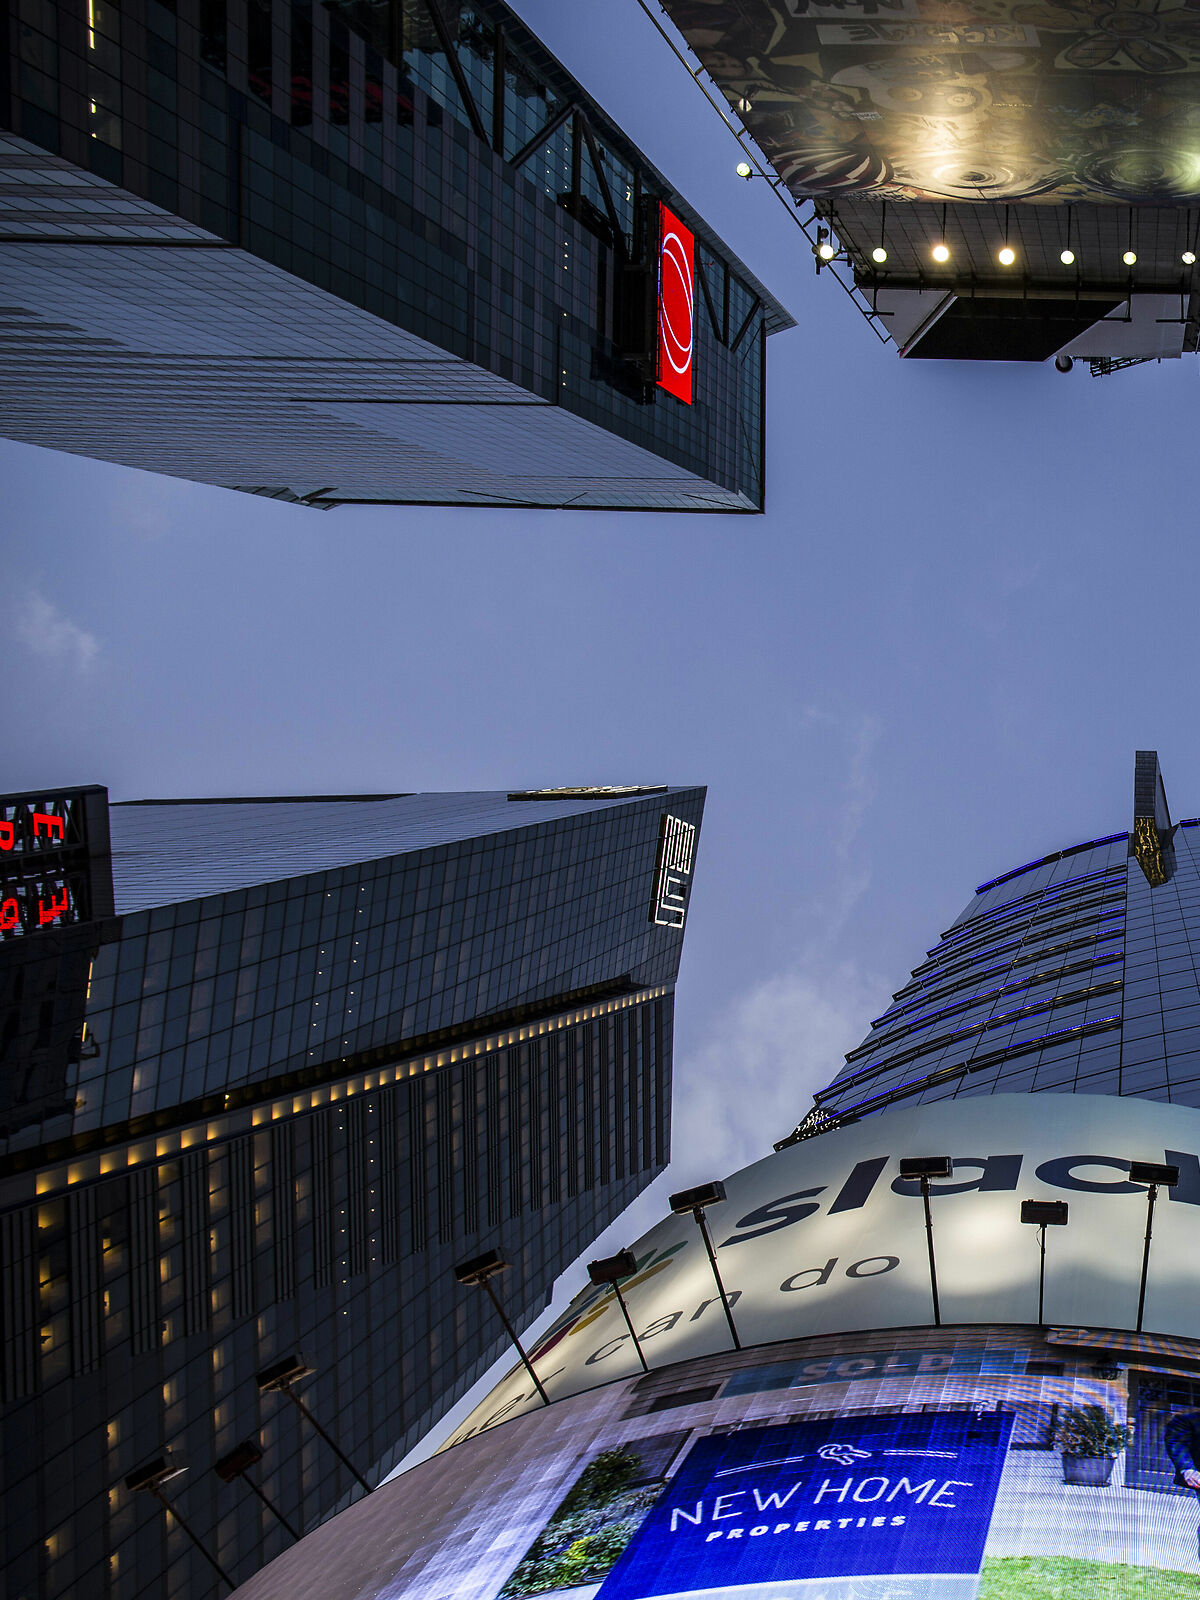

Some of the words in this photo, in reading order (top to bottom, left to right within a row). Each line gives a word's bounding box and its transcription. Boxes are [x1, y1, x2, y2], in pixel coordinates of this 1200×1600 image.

[585, 1291, 742, 1365] can
[780, 1256, 900, 1292] do
[803, 1354, 954, 1382] SOLD
[670, 1482, 802, 1531] NEW
[814, 1477, 973, 1508] HOME
[705, 1515, 906, 1542] PROPERTIES
